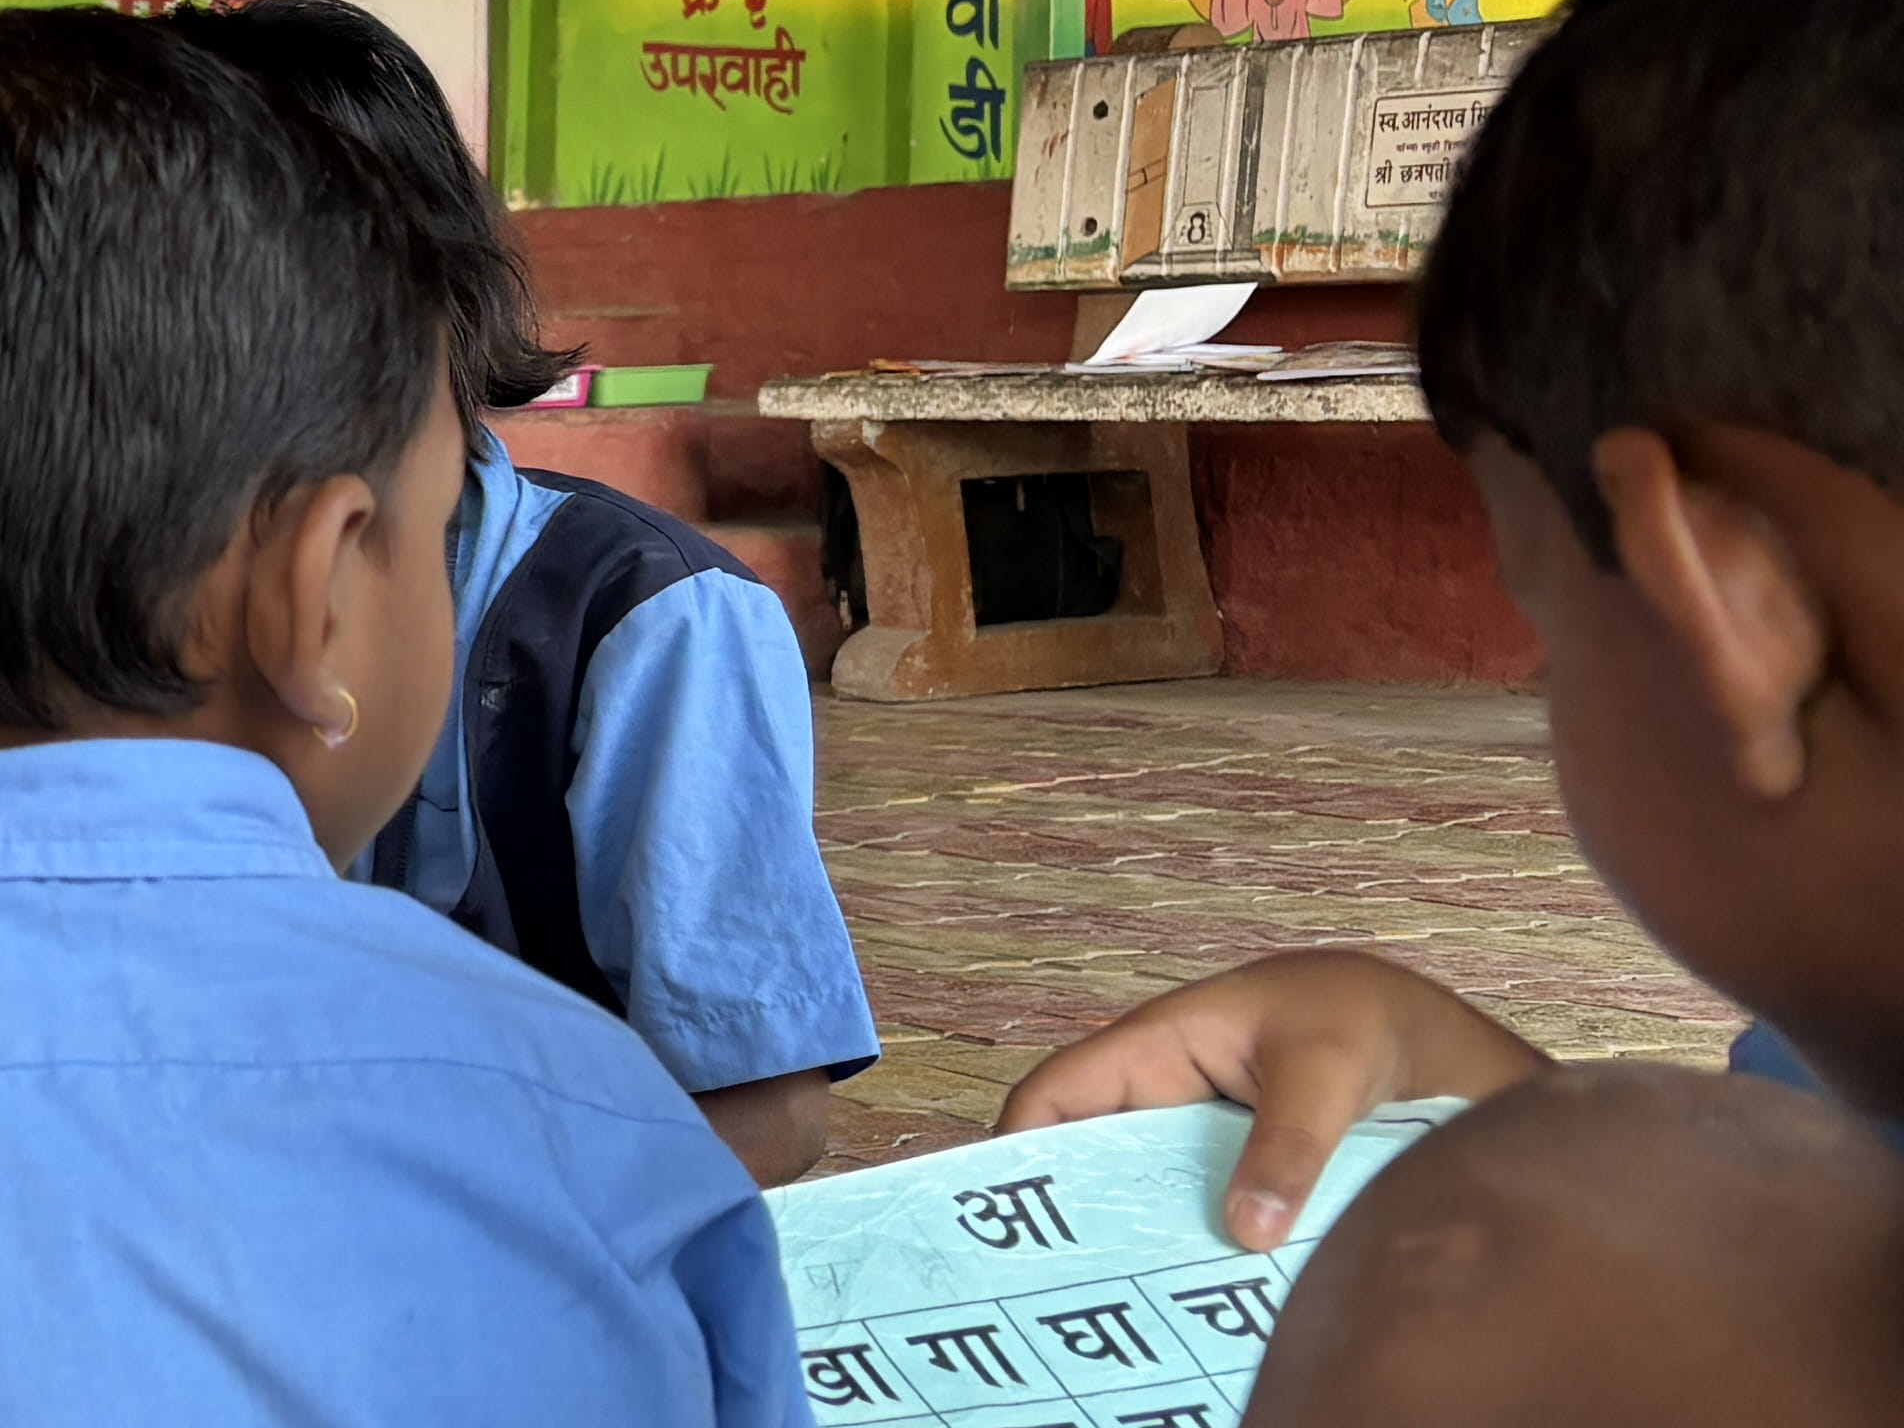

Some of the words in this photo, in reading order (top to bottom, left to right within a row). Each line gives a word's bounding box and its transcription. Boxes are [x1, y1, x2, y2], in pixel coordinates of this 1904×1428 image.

[639, 36, 806, 114] उपरवाही
[1374, 158, 1393, 185] श्री
[952, 1174, 1080, 1251] आ
[905, 1324, 1030, 1389] गा
[1036, 1301, 1163, 1369] घा
[1169, 1276, 1279, 1343] चा
